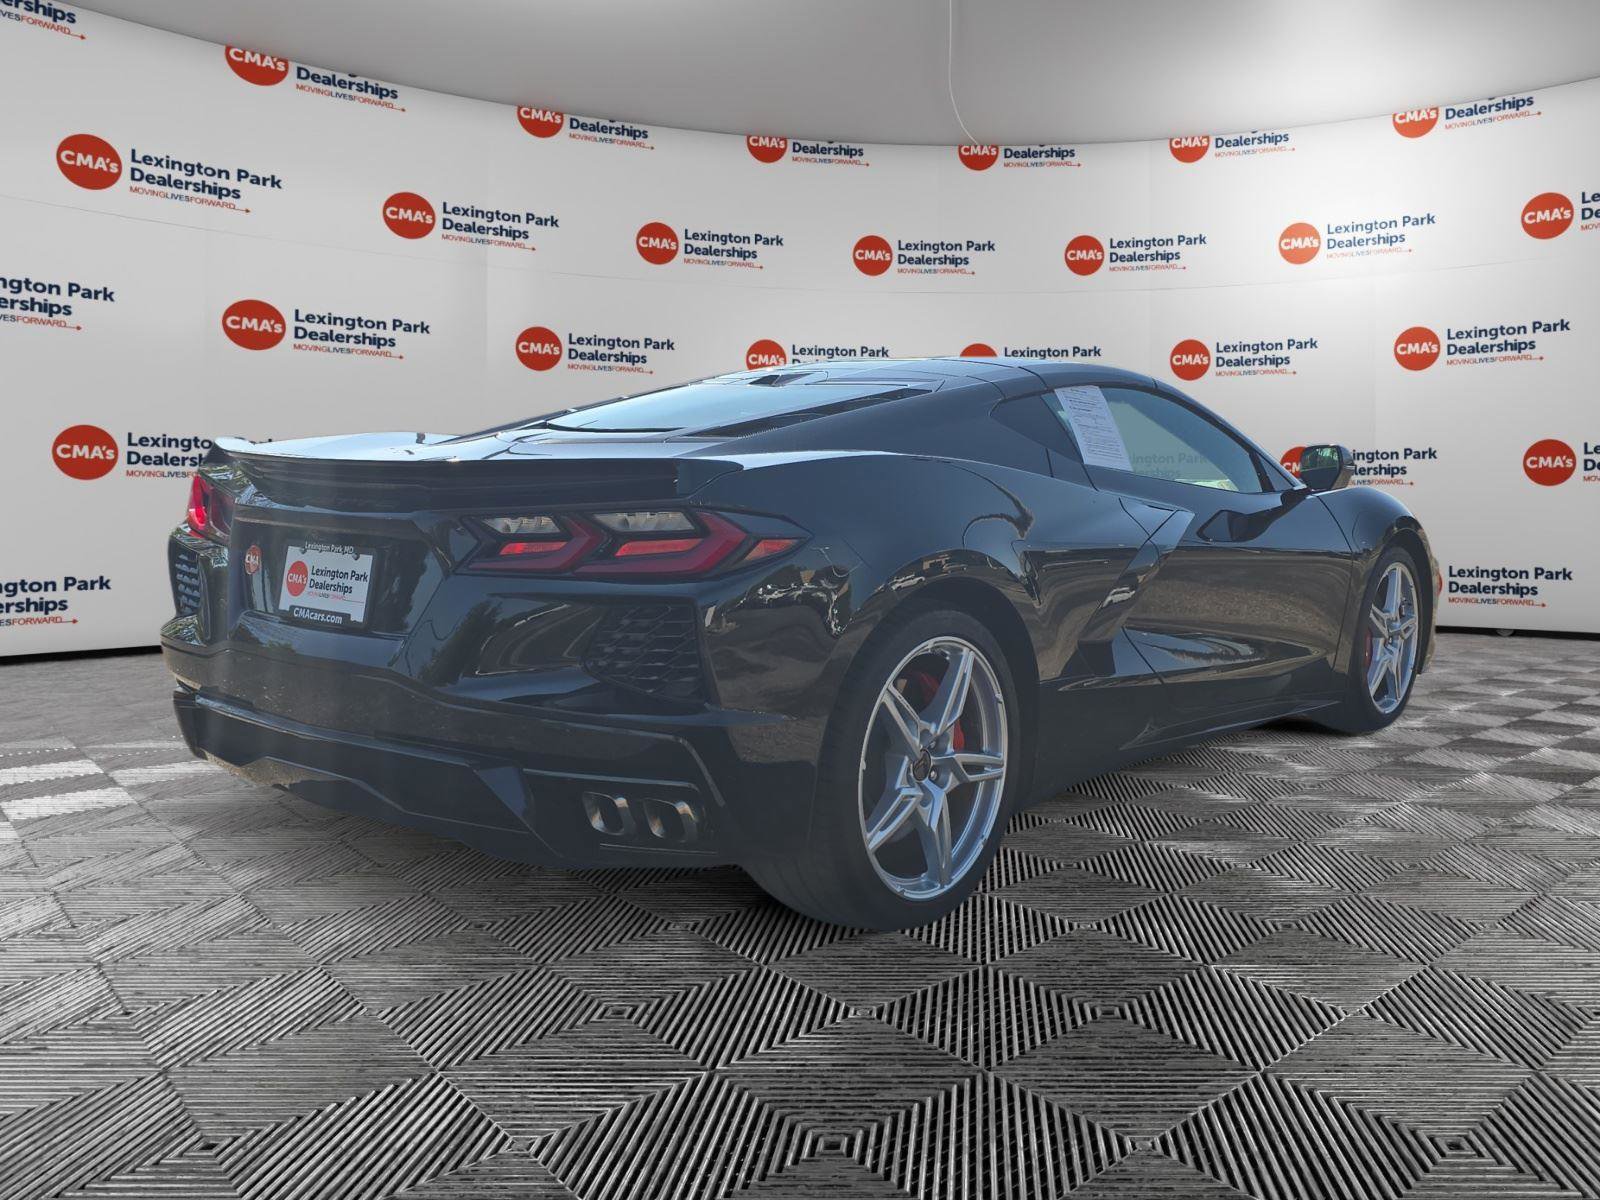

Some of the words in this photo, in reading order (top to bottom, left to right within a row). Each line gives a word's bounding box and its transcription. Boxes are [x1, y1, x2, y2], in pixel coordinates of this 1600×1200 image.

[229, 48, 286, 72] CMA's
[296, 66, 398, 100] Dealerships
[520, 107, 561, 124] CMA's
[1395, 108, 1438, 124] CMA's
[1445, 96, 1534, 120] Dealerships
[569, 117, 648, 140] Dealerships
[749, 136, 785, 149] CMA's
[1171, 136, 1208, 149] CMA's
[1215, 132, 1289, 149] Dealerships
[792, 142, 864, 158] Dealerships
[961, 145, 997, 156] CMA's
[1004, 147, 1075, 160] Dealerships
[60, 150, 119, 174] CMA's
[131, 148, 230, 181] Lexington
[237, 168, 283, 189] Park
[130, 167, 241, 200] Dealerships
[386, 206, 433, 225] CMA's
[443, 201, 521, 223] Lexington
[526, 212, 560, 228] Park
[1524, 207, 1572, 224] CMA's
[442, 218, 529, 241] Dealerships
[1327, 218, 1398, 235] Lexington
[1402, 213, 1436, 227] Park
[638, 236, 677, 250] CMA's
[684, 228, 750, 246] Lexington
[755, 233, 783, 246] Park
[1110, 237, 1173, 250] Lexington
[1178, 234, 1206, 246] Park
[1280, 236, 1319, 251] CMA's
[1327, 232, 1406, 250] Dealerships
[684, 243, 757, 261] Dealerships
[855, 249, 891, 261] CMA's
[898, 239, 962, 254] Lexington
[966, 240, 995, 251] Park
[1066, 249, 1103, 261] CMA's
[897, 254, 969, 268] Dealerships
[1109, 250, 1180, 263] Dealerships
[68, 282, 115, 302] Park
[225, 315, 283, 334] CMA's
[294, 308, 387, 331] Lexington
[392, 318, 430, 334] Park
[1447, 325, 1527, 341] Lexington
[1532, 318, 1570, 334] Park
[294, 326, 396, 349] Dealerships
[568, 333, 640, 350] Lexington
[644, 337, 675, 351] Park
[1216, 341, 1283, 355] Lexington
[1287, 337, 1318, 350] Park
[518, 341, 560, 356] CMA's
[792, 344, 857, 359] Lexington
[860, 346, 889, 358] Park
[1004, 347, 1069, 360] Lexington
[1072, 346, 1101, 357] Park
[1397, 341, 1438, 356] CMA's
[1447, 339, 1536, 356] Dealerships
[568, 348, 647, 366] Dealerships
[748, 353, 785, 366] CMA's
[1172, 353, 1209, 366] CMA's
[1216, 354, 1290, 368] Dealerships
[127, 432, 213, 453] Lexingto
[56, 443, 115, 460] CMA's
[1352, 448, 1399, 463] ington
[1404, 447, 1437, 460] Park
[1354, 463, 1407, 478] lerships
[1526, 455, 1574, 469] CMA's
[305, 541, 330, 554] Lexington
[287, 573, 307, 585] CMA's
[311, 565, 349, 581] Lexington
[350, 569, 369, 583] Park
[1449, 565, 1529, 582] Lexington
[1534, 566, 1573, 581] Park
[0, 579, 57, 598] gton
[64, 575, 111, 592] Park
[309, 578, 353, 595] Dealerships
[1448, 581, 1538, 598] Dealerships
[293, 607, 343, 625] CMAcars.com
